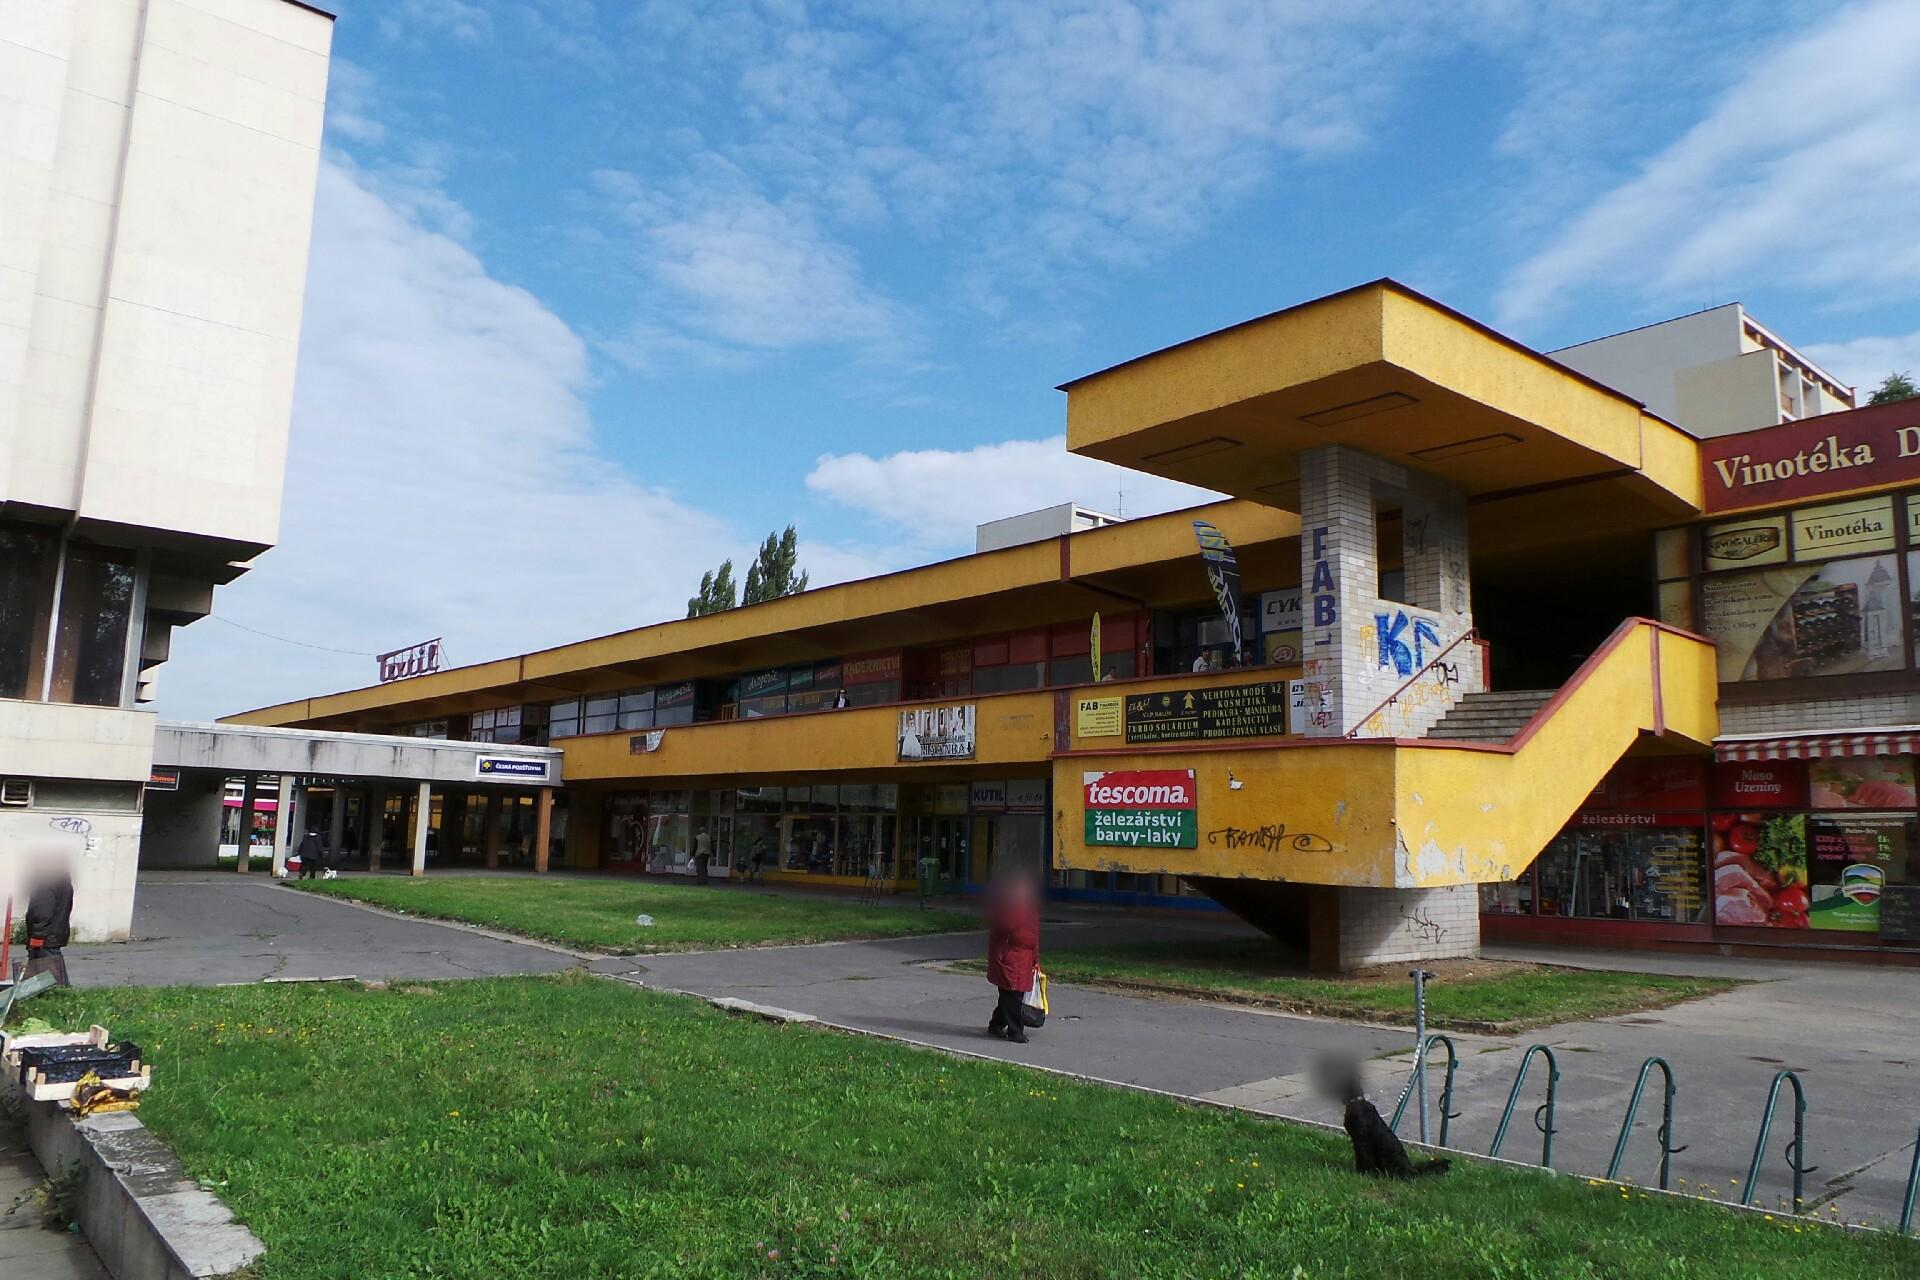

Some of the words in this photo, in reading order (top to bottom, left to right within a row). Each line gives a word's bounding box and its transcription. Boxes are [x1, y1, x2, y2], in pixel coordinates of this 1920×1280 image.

[1713, 436, 1875, 489] Vinotéka
[1805, 517, 1883, 541] Vinotéka
[1311, 527, 1336, 627] FAB
[376, 643, 440, 682] Textil
[1081, 702, 1098, 711] FAB
[1217, 697, 1266, 708] KOSMETIKA
[1128, 722, 1153, 733] TURBO
[495, 762, 511, 770] ČESKÁ
[1742, 770, 1773, 780] Maso
[1735, 781, 1782, 794] Uzeniny
[974, 789, 1004, 801] KUTIL
[1095, 811, 1182, 827] železářství
[1582, 814, 1656, 824] železářství
[1096, 827, 1181, 846] barvy-laky
